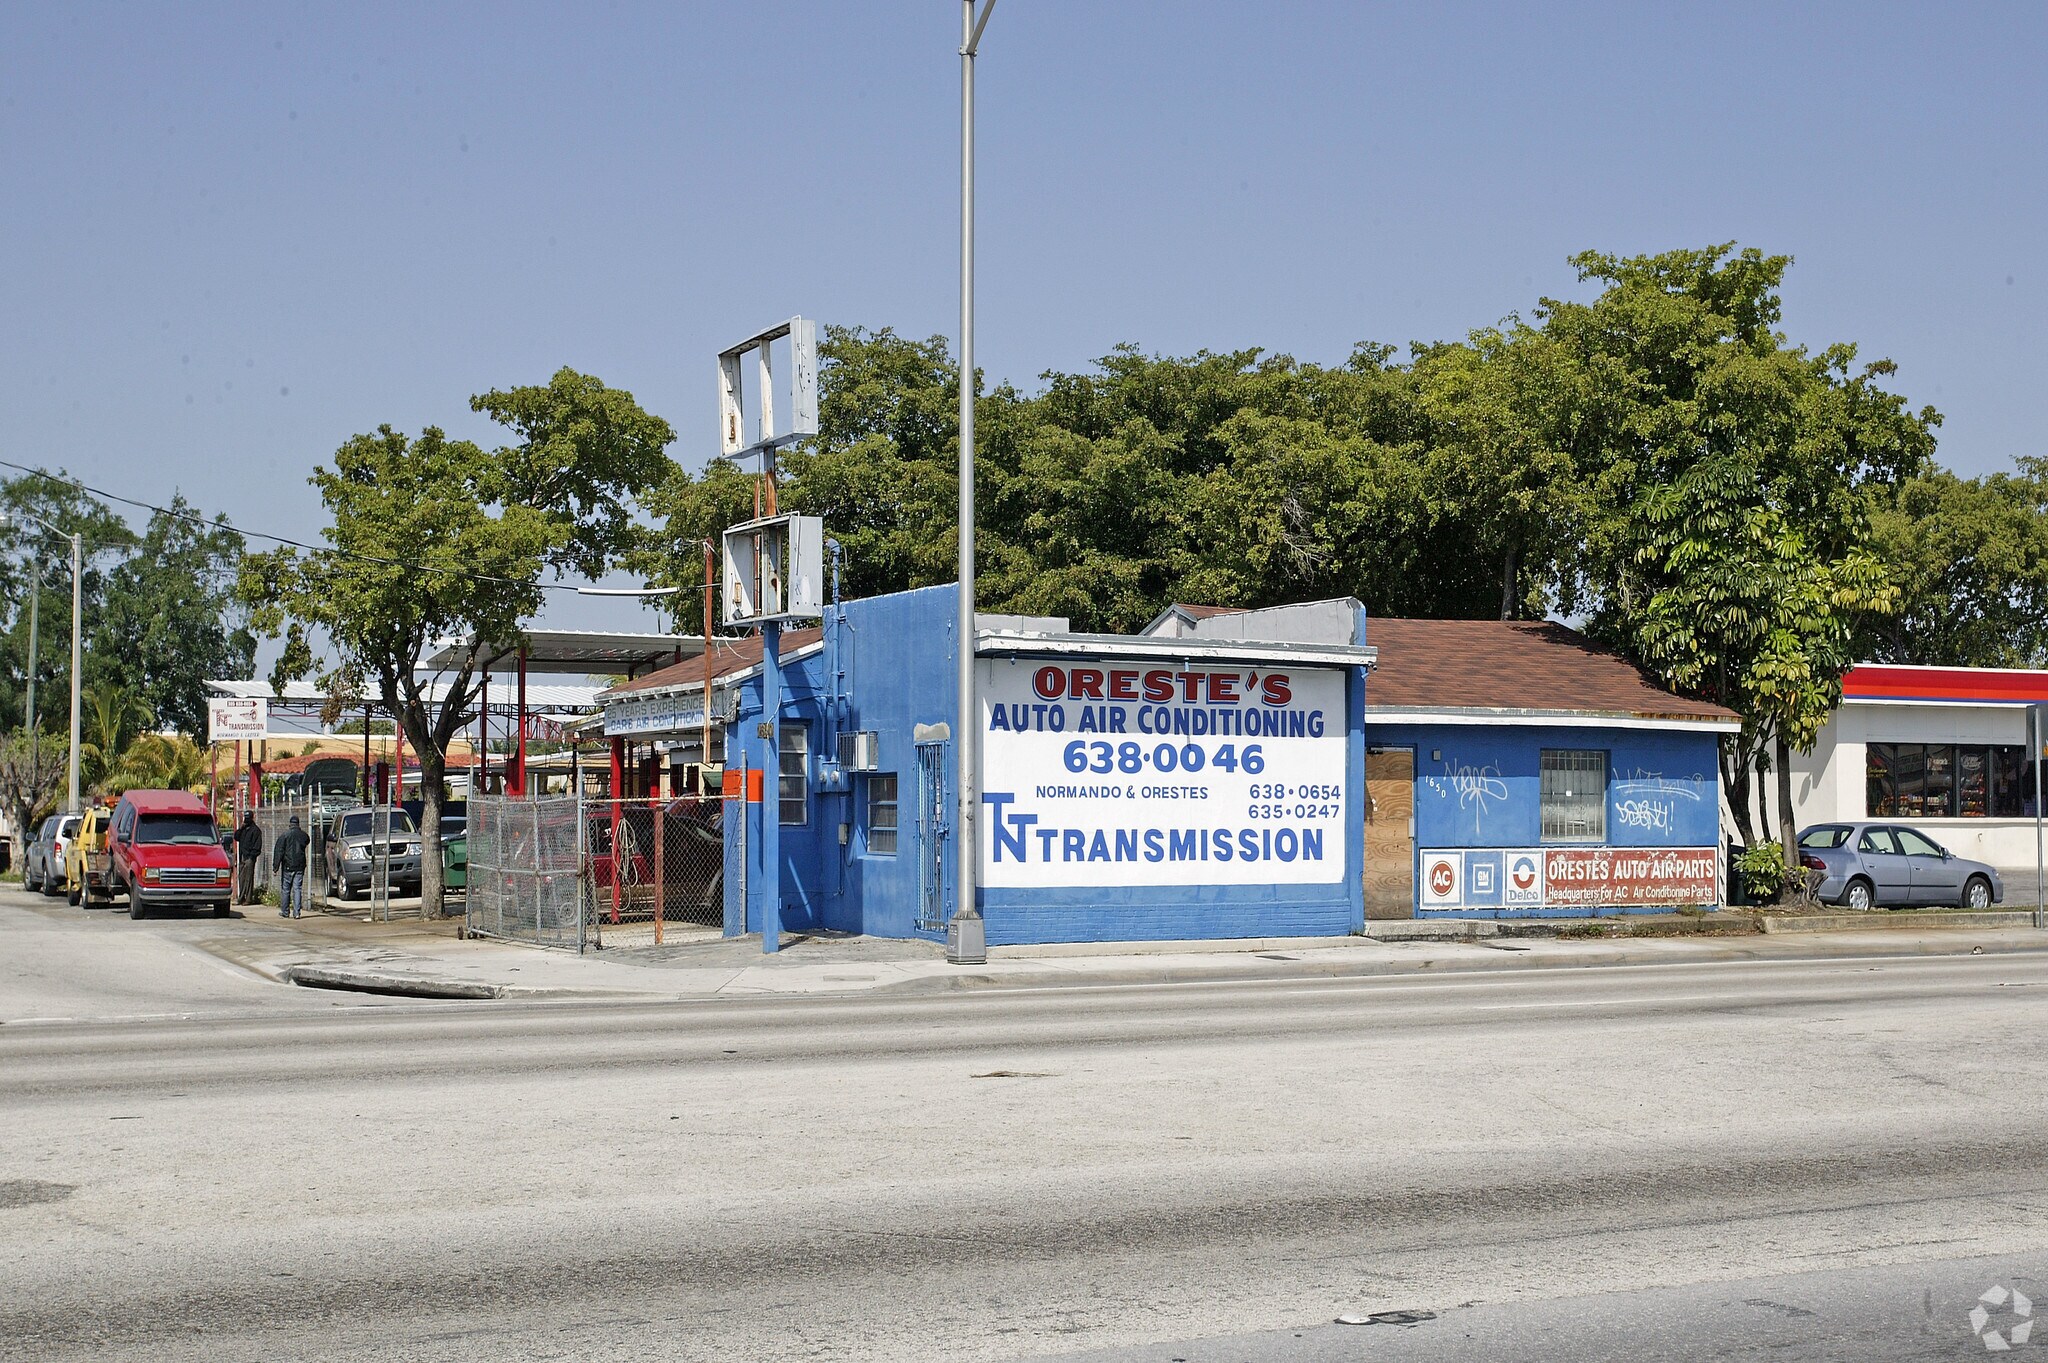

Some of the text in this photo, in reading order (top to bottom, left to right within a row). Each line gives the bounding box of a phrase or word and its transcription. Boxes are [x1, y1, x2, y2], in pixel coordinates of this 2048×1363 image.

[1032, 666, 1292, 706] ORESTE'S
[620, 704, 647, 718] YEARS
[651, 697, 704, 715] EXPERIENCE
[636, 716, 649, 728] AIR
[989, 703, 1325, 738] AUTO AIR CONDITIONING
[1036, 785, 1209, 800] NORMANDO & ORESTES
[1036, 828, 1323, 863] TRANSMISSION
[1433, 869, 1450, 886] AC
[1477, 871, 1489, 881] GM
[1548, 860, 1609, 880] ORESTES
[1613, 860, 1647, 880] AUTO
[1508, 889, 1538, 901] Delco
[1548, 884, 1713, 900] Headquarters For AC Air Conditioning Parts
